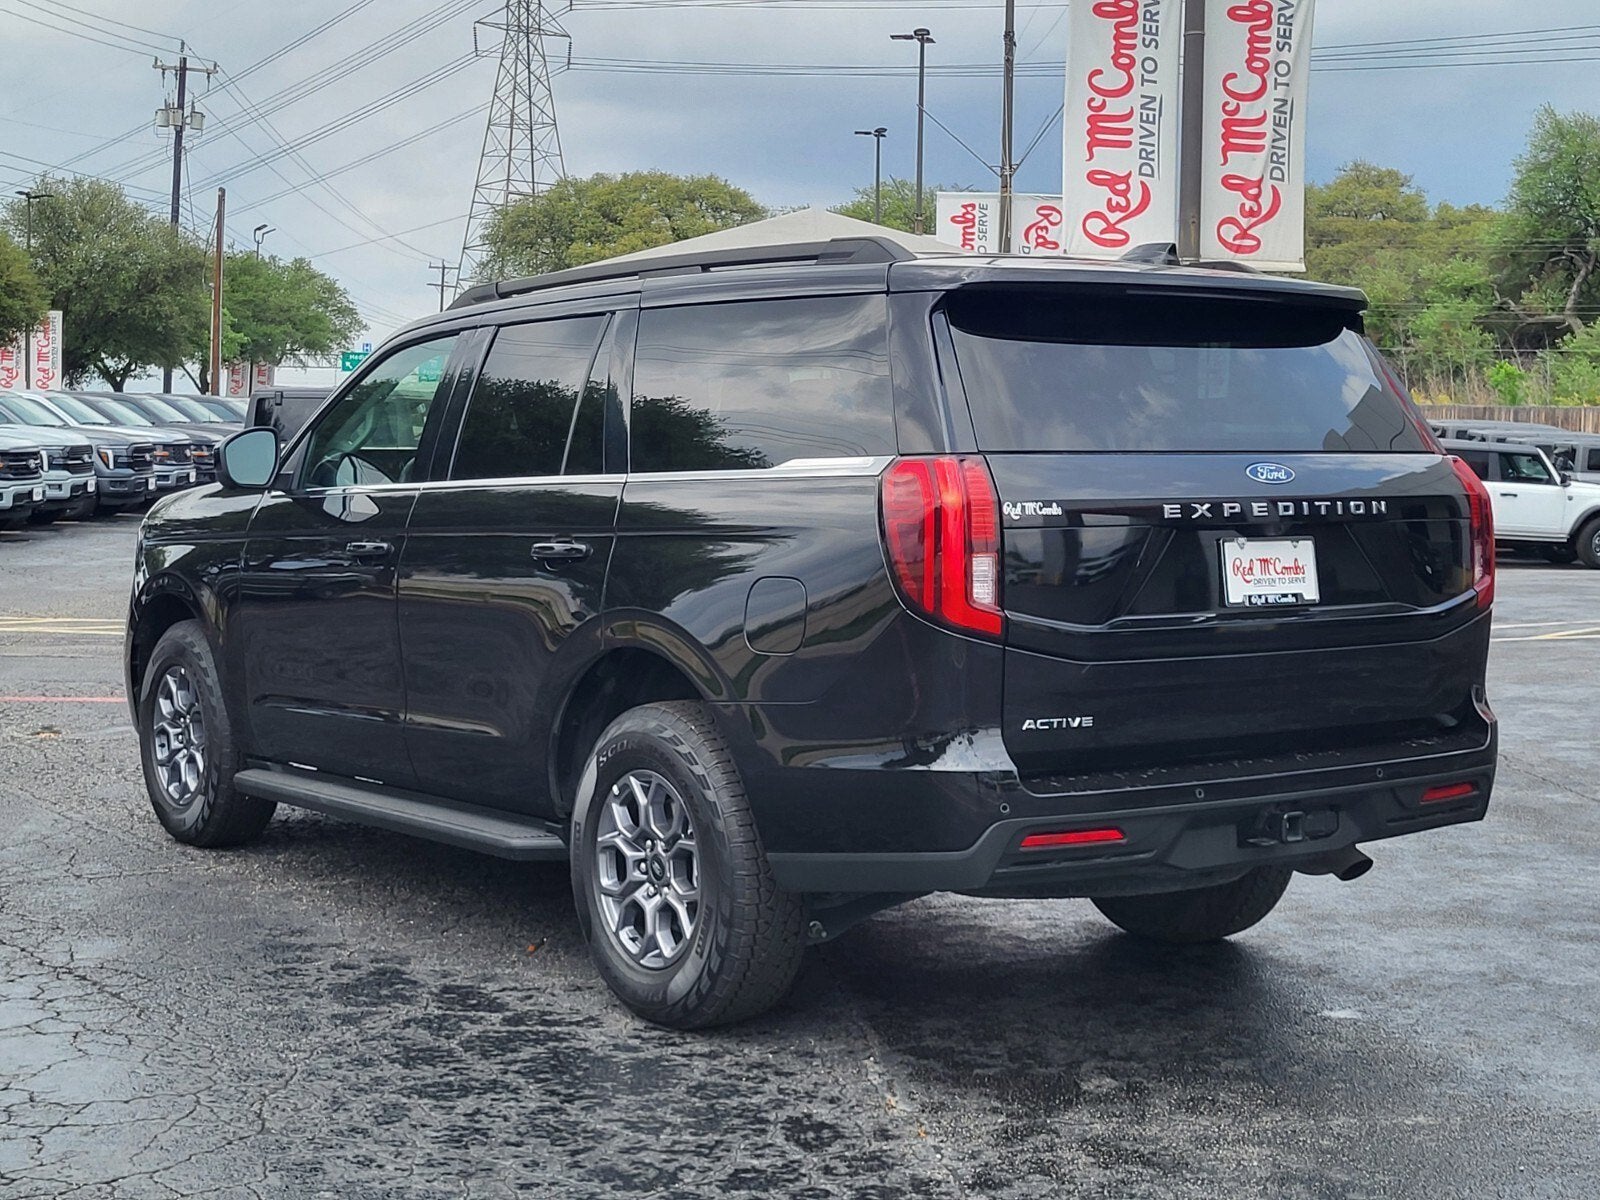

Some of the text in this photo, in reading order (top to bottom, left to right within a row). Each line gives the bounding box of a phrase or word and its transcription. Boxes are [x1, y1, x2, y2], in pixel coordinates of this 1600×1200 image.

[1138, 0, 1161, 179] DRIVEN TO SERV
[1269, 0, 1295, 183] DRIVEN TO SERV
[1082, 0, 1152, 248] Red McComb
[1216, 0, 1282, 255] Red McComb
[950, 202, 977, 251] ombs
[977, 202, 989, 254] O SERVE
[1023, 205, 1063, 251] Red
[0, 366, 19, 389] Red
[36, 367, 55, 390] Red
[1002, 501, 1063, 520] Red McCombs
[1163, 500, 1388, 519] EXPEDITION
[1232, 556, 1306, 584] Red McCombs
[1253, 576, 1306, 586] DRIVEN TO SERVE
[1021, 716, 1094, 731] ACTIVE
